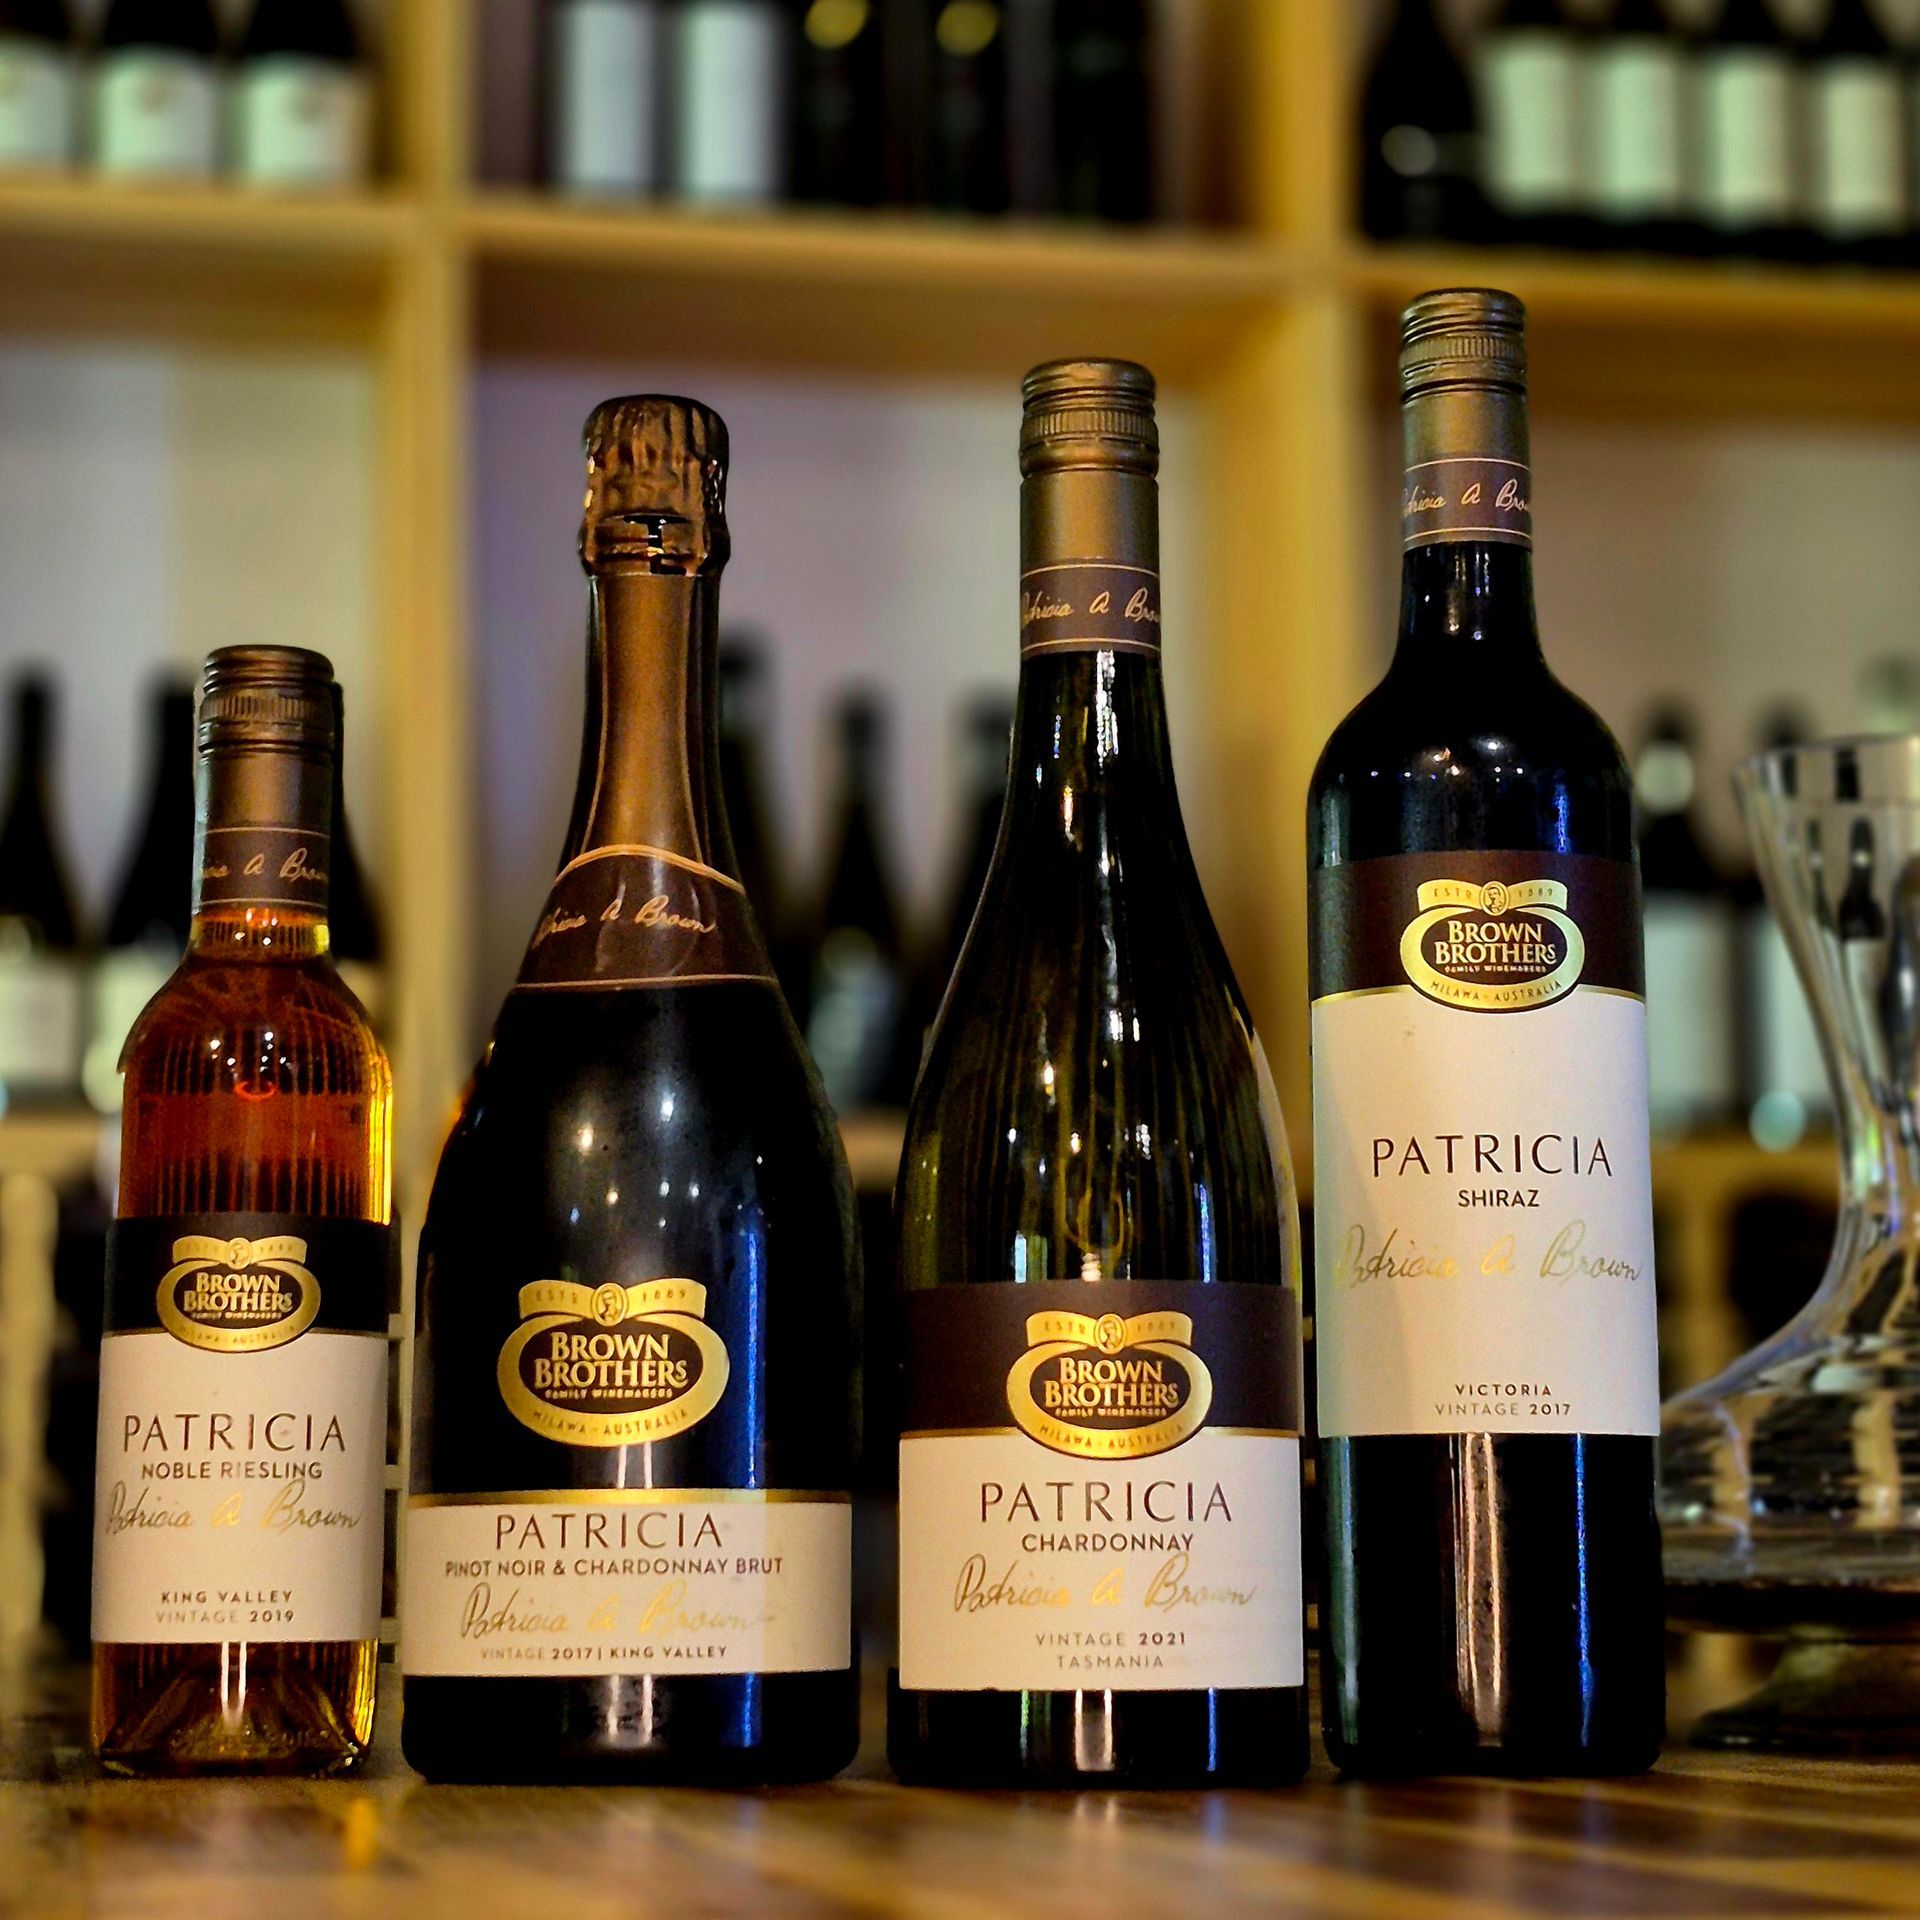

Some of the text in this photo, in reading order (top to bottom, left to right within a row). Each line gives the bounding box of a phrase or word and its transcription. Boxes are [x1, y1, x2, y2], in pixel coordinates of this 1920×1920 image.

[1448, 920, 1543, 943] BROWN
[1434, 941, 1559, 966] BROTHERS
[1494, 980, 1562, 1002] AUSTRALIA
[1373, 1134, 1613, 1178] PATRICIA
[1458, 1189, 1540, 1208] SHIRAZ
[1539, 1218, 1643, 1287] Brown
[195, 1272, 281, 1292] BROWN
[183, 1290, 294, 1313] BROTHERS
[550, 1331, 671, 1361] BROWN
[534, 1357, 690, 1389] BROTHERS
[1060, 1357, 1163, 1384] BROWN
[1044, 1380, 1179, 1408] BROTHERS
[1455, 1383, 1552, 1397] VICTORIA
[1435, 1403, 1571, 1416] VINTAGE 2017
[123, 1412, 347, 1452] PATRICIA
[603, 1408, 689, 1436] AUSTRALIA
[141, 1461, 323, 1480] NOBLE RIESLING
[260, 1477, 361, 1535] Brown
[980, 1480, 1233, 1523] PATRICIA
[495, 1511, 723, 1551] PATRICIA
[1021, 1532, 1194, 1553] CHARDONNAY
[445, 1556, 784, 1577] PINOT NOIR & CHARDONNAY BRUT
[953, 1553, 1072, 1613] Patricia
[1143, 1550, 1258, 1613] Brown
[161, 1590, 293, 1603] KING VALLEY
[155, 1610, 295, 1624] VINTAGE 2019
[459, 1580, 570, 1640] Patricia
[638, 1578, 777, 1637] Brown
[1035, 1631, 1187, 1647] VINTAGE 2021
[480, 1647, 547, 1660] VINTAGE
[551, 1647, 594, 1660] 2017
[610, 1646, 655, 1660] KING
[663, 1646, 727, 1659] VALLEY
[1056, 1654, 1164, 1669] TASMANIA
